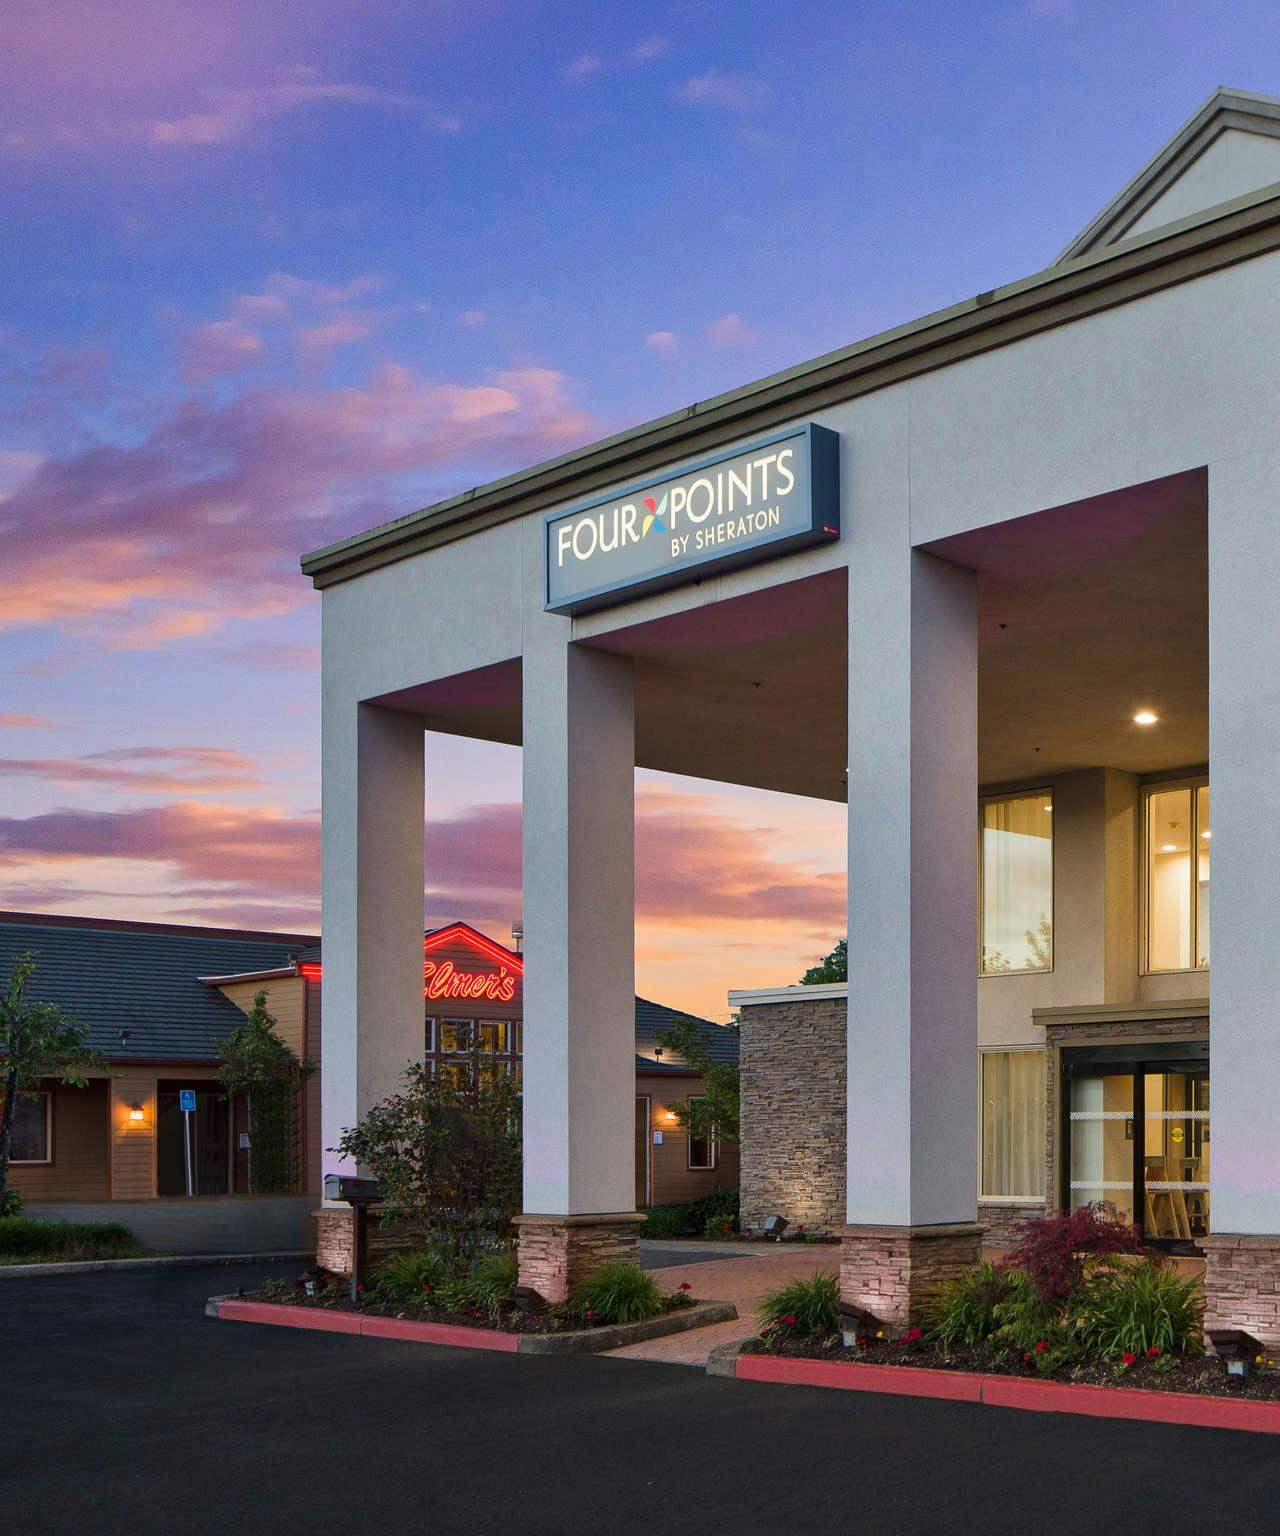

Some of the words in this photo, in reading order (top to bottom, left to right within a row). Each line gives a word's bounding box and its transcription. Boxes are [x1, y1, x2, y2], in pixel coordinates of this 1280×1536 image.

[558, 503, 640, 567] FOUR
[670, 449, 795, 530] POINTS
[671, 534, 690, 558] BY
[695, 505, 780, 550] SHERATON
